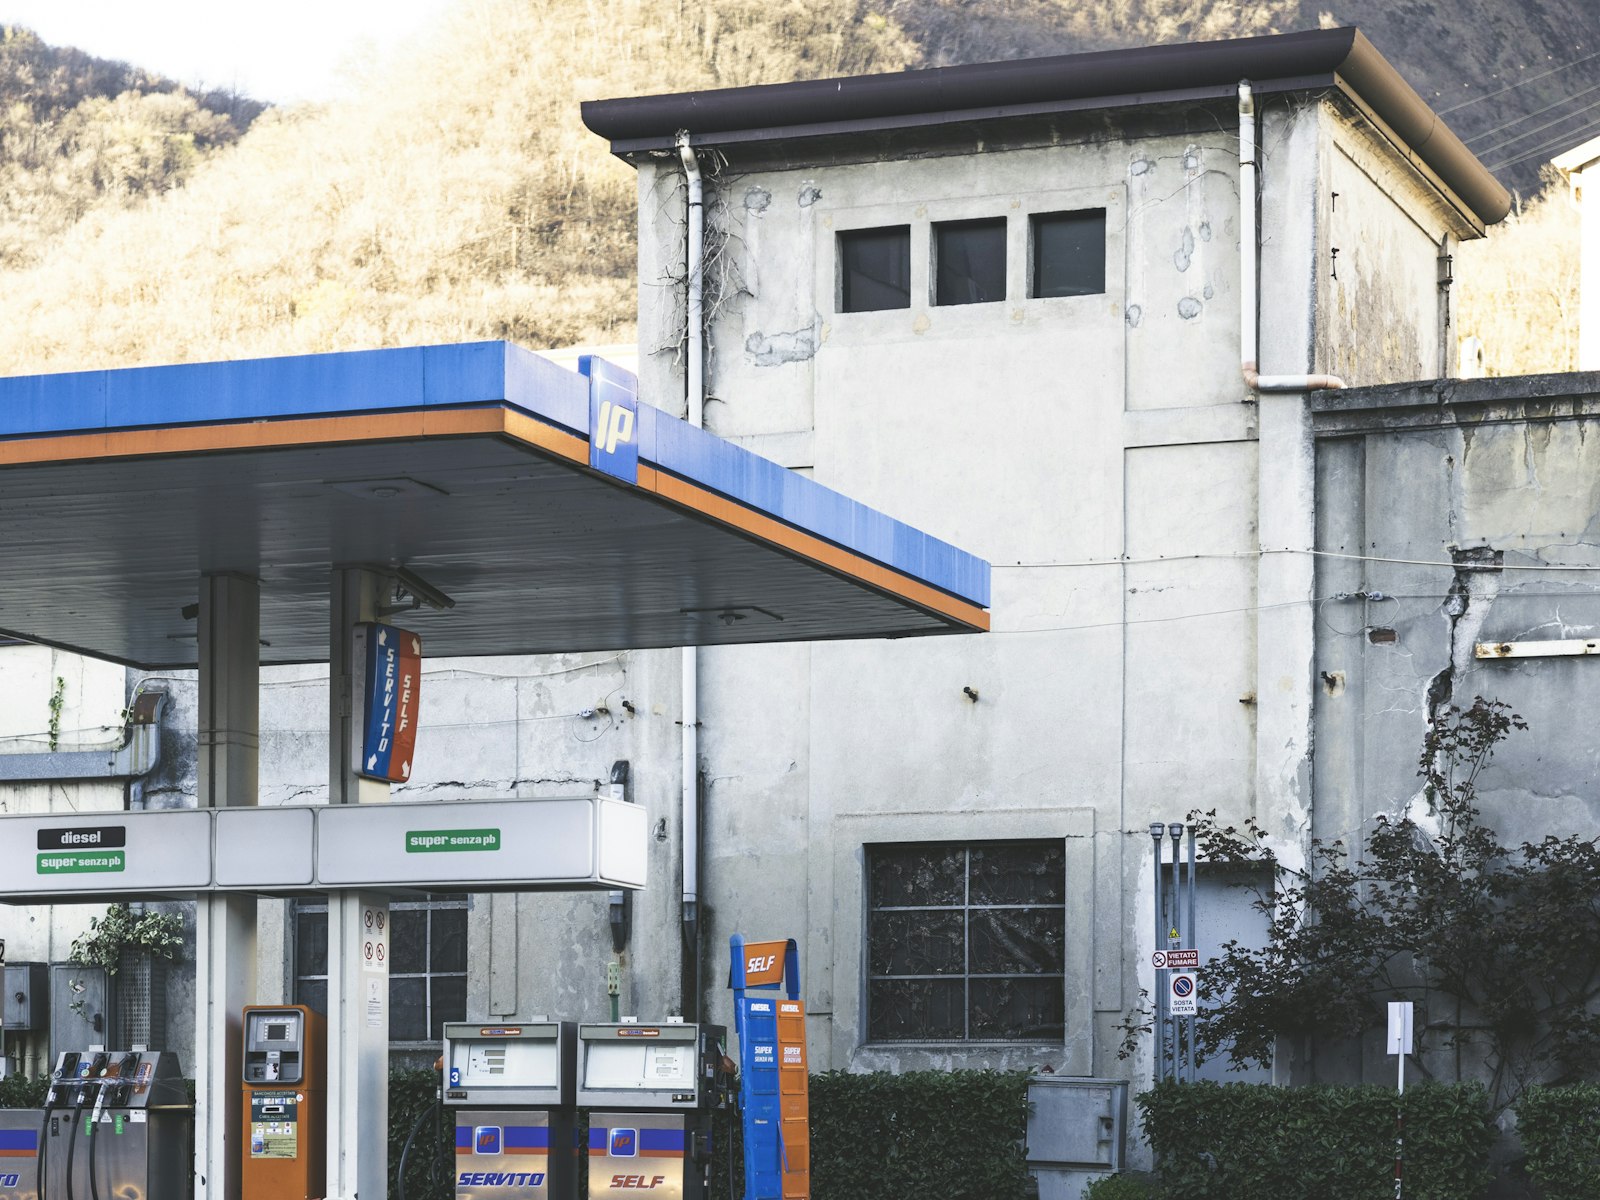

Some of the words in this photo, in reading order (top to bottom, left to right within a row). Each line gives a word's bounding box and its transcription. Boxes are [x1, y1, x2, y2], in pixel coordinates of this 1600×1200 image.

[595, 400, 635, 455] IP
[378, 648, 395, 752] SERVITO
[399, 674, 412, 732] SELF
[60, 830, 101, 844] diesel
[410, 835, 449, 848] super
[450, 836, 481, 845] senza
[41, 857, 77, 869] super
[78, 858, 108, 867] senza
[747, 955, 776, 973] SELF
[751, 1003, 770, 1012] DIESEL
[781, 1004, 799, 1013] DIESEL
[755, 1046, 773, 1054] SUPER
[784, 1047, 801, 1055] SUPER
[451, 1072, 459, 1083] 3
[479, 1134, 496, 1146] IP
[614, 1136, 631, 1148] IP
[458, 1172, 545, 1187] SERVITO
[609, 1174, 666, 1189] SELF
